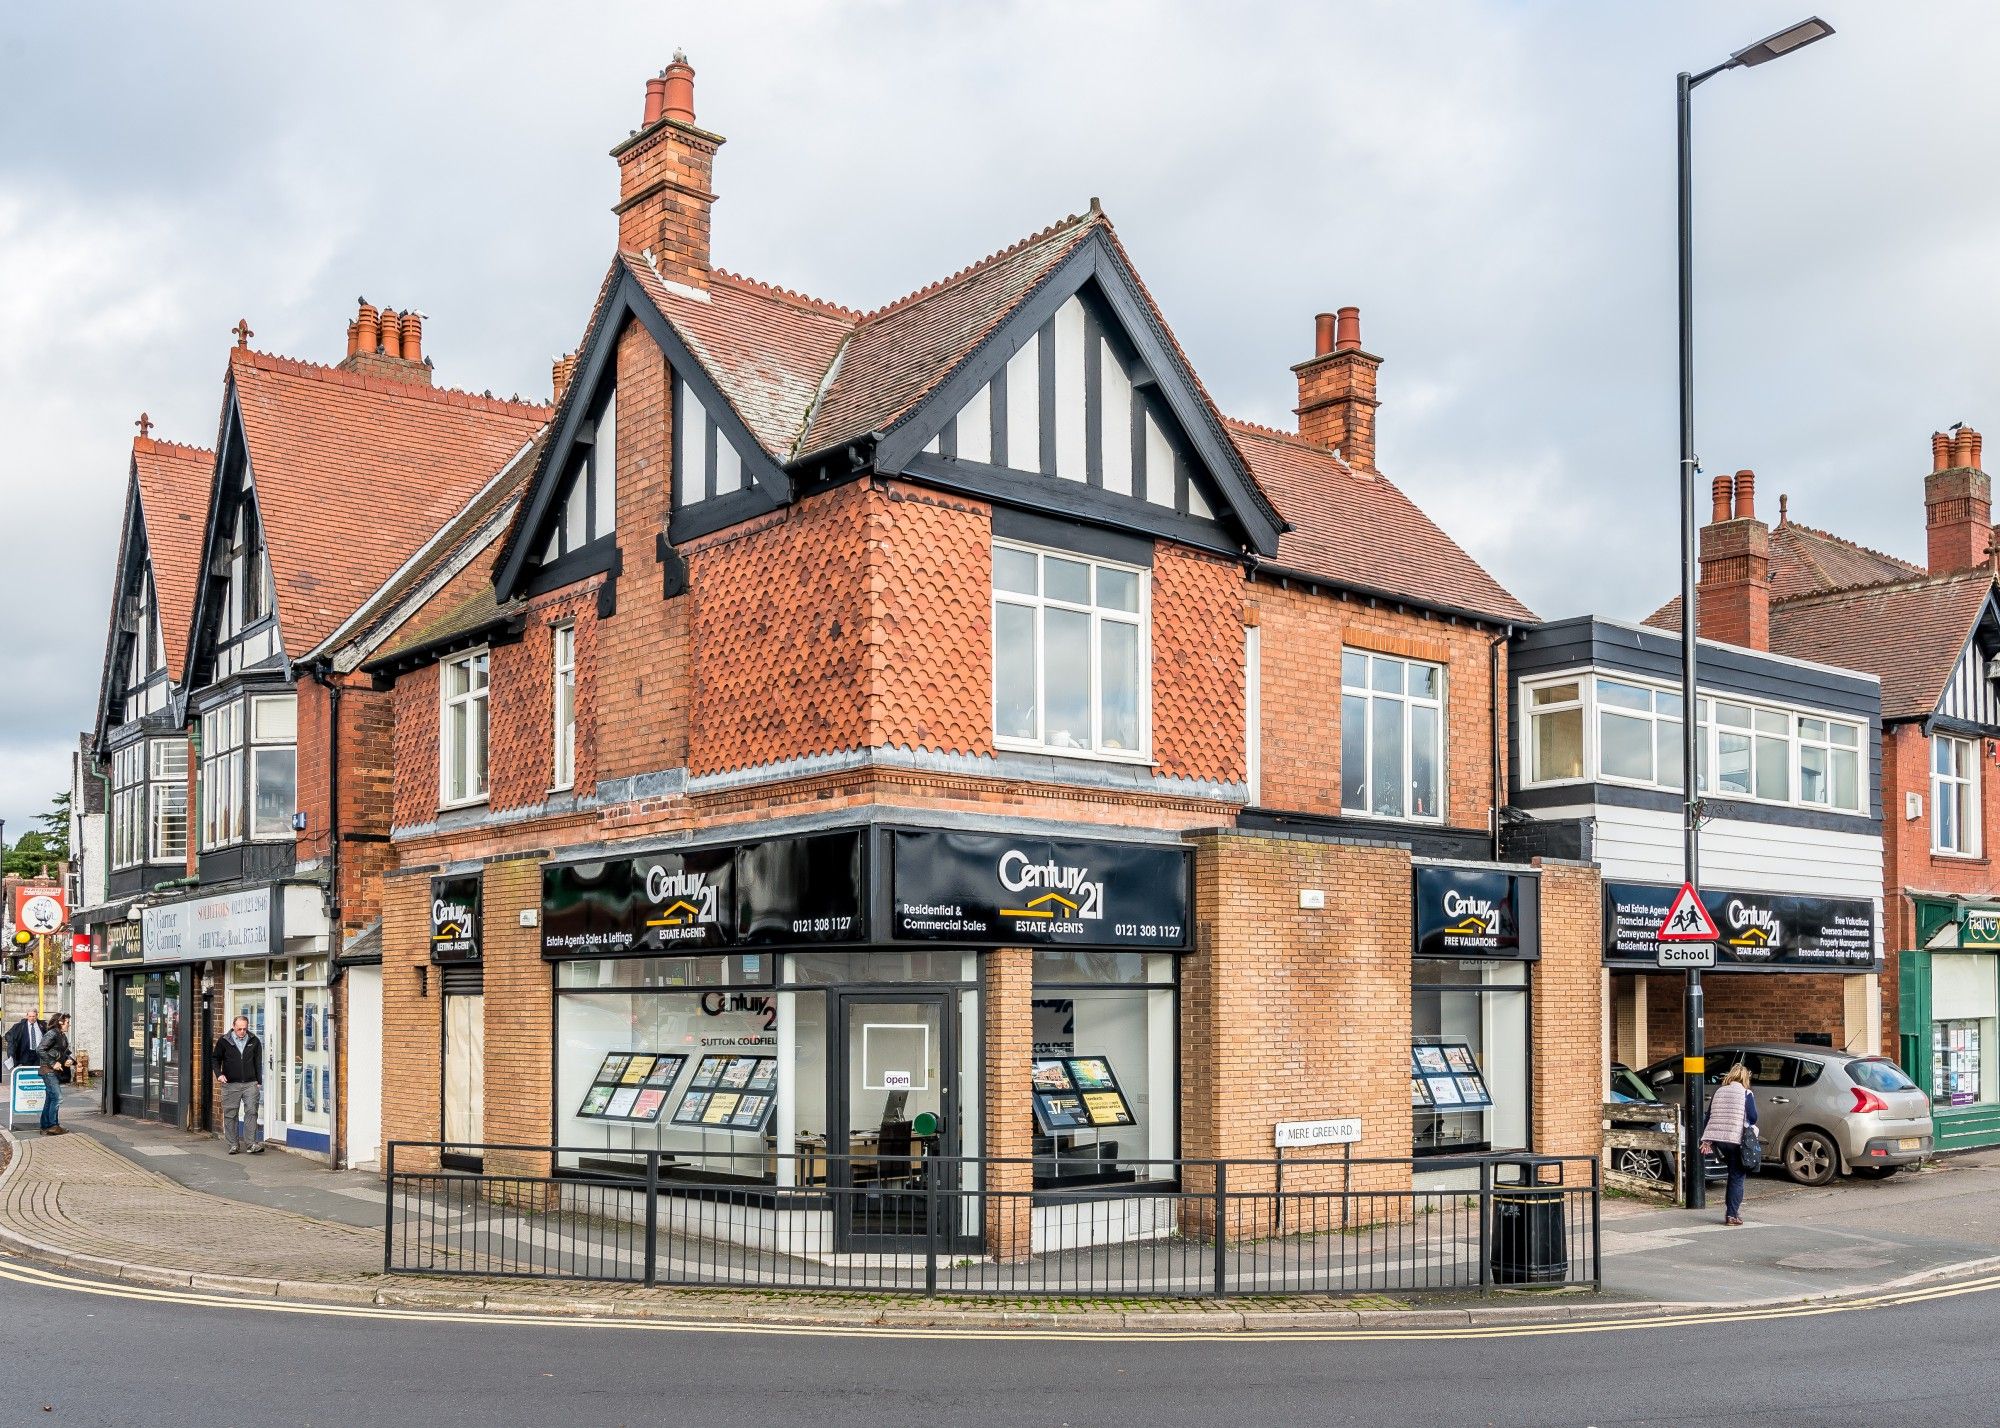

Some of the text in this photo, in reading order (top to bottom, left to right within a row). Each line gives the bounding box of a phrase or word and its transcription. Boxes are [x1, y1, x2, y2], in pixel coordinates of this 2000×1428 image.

[999, 849, 1104, 920] Century 21
[646, 864, 720, 923] Century 21
[903, 904, 962, 917] Residential &
[1443, 889, 1500, 935] Century 21
[1617, 903, 1669, 917] Real Estate Agents
[432, 899, 472, 938] Century 21
[793, 916, 851, 933] 0121 308 1127
[1617, 916, 1664, 927] Financial Assista
[1728, 899, 1781, 947] Century 21
[1835, 916, 1869, 927] Free Valuations
[903, 919, 987, 932] Commercial Sales
[1015, 920, 1084, 934] ESTATE AGENTS
[1115, 924, 1181, 938] 0121 308 1127
[1821, 927, 1869, 937] Overseas Investments
[546, 932, 633, 948] Estate Agents Sales & Lettings
[659, 927, 706, 940] ESTATE AGENTS
[1617, 929, 1655, 940] Conveyance
[437, 941, 470, 951] LETTING AGENT
[1444, 936, 1497, 947] FREE VALUATIONS
[1617, 941, 1649, 951] Residential
[1649, 943, 1654, 951] &
[1819, 938, 1869, 949] Property Management
[1664, 948, 1710, 960] School
[1736, 947, 1770, 956] ESTATE AGENTS
[1798, 948, 1869, 960] Renovation and Sale of Property
[762, 1006, 778, 1032] 2
[701, 1038, 736, 1046] SUTTON
[886, 1076, 909, 1085] open
[1287, 1124, 1353, 1140] MERE GREEN RD
